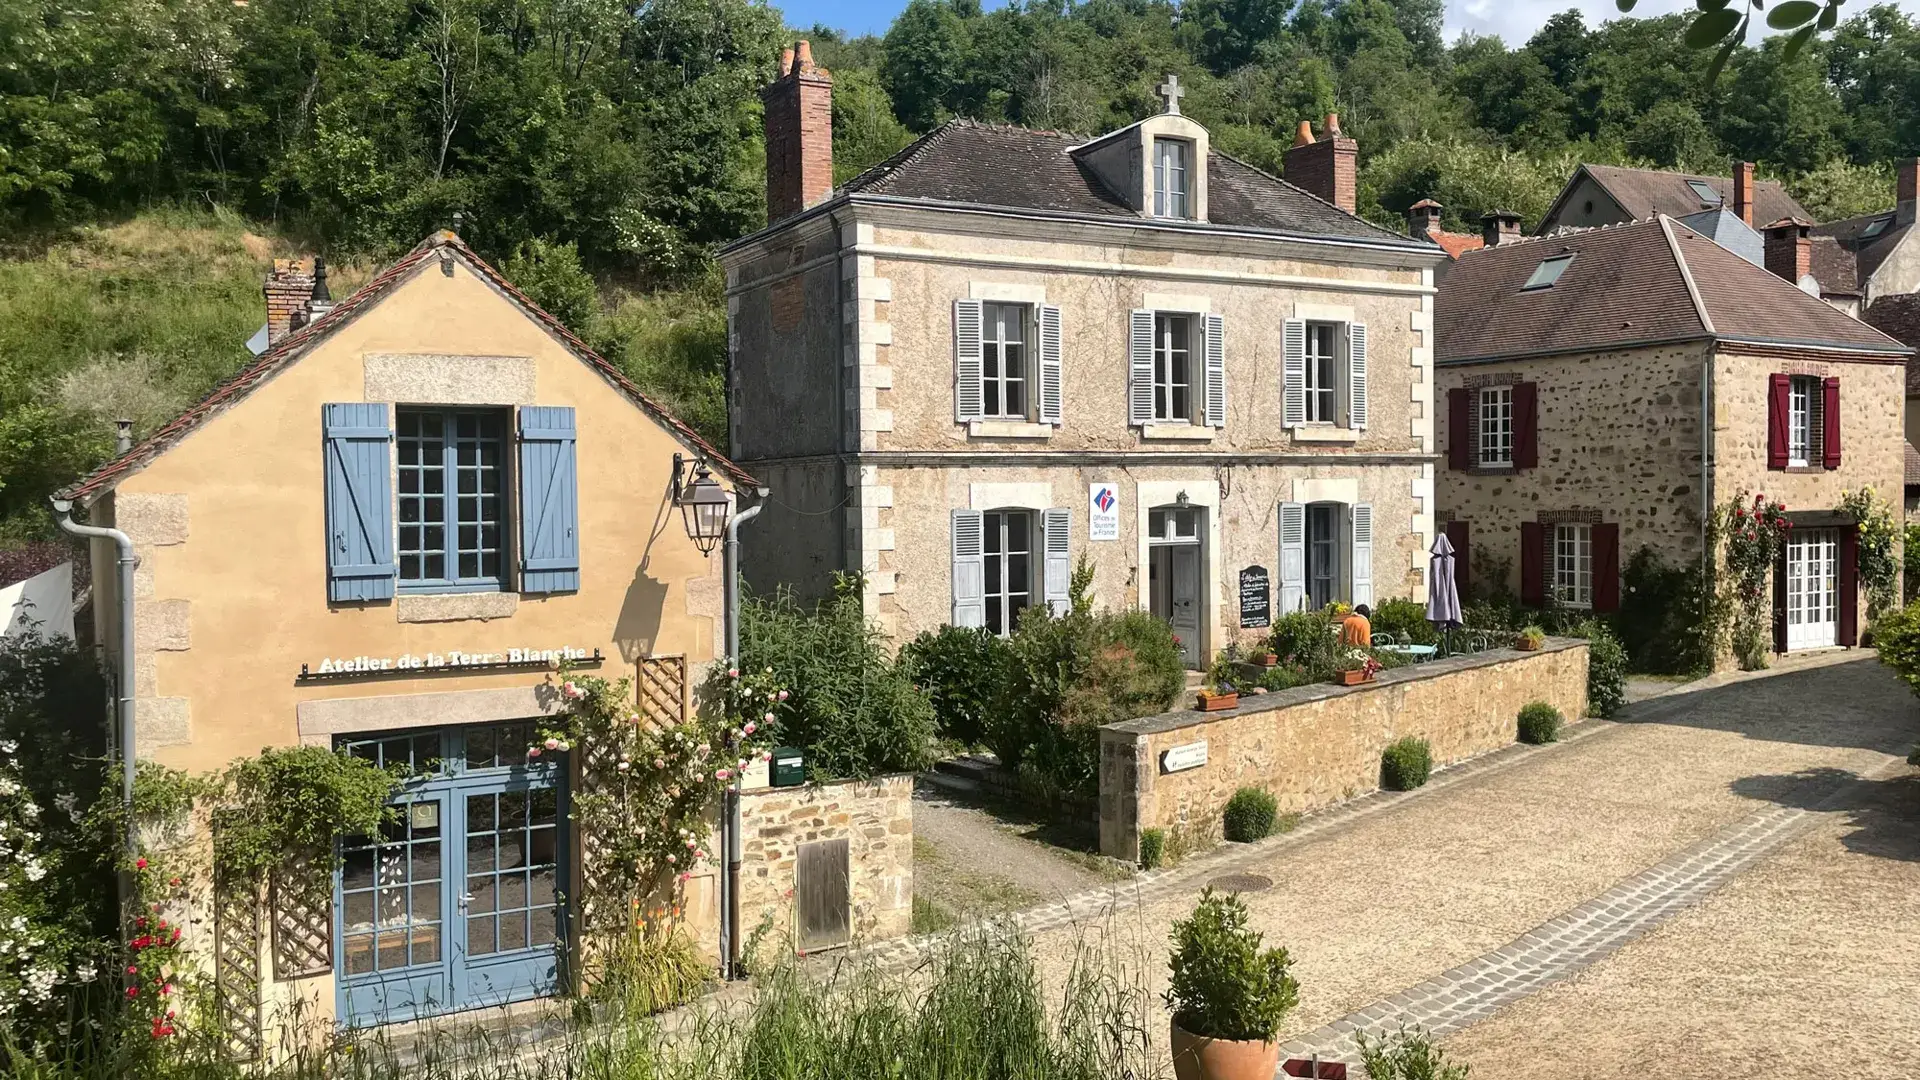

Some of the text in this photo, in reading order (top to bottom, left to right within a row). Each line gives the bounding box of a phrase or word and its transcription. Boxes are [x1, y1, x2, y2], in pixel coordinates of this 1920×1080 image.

[318, 656, 393, 673] Atelier
[397, 653, 421, 669] de
[425, 652, 446, 667] la
[507, 645, 587, 663] Blanche
